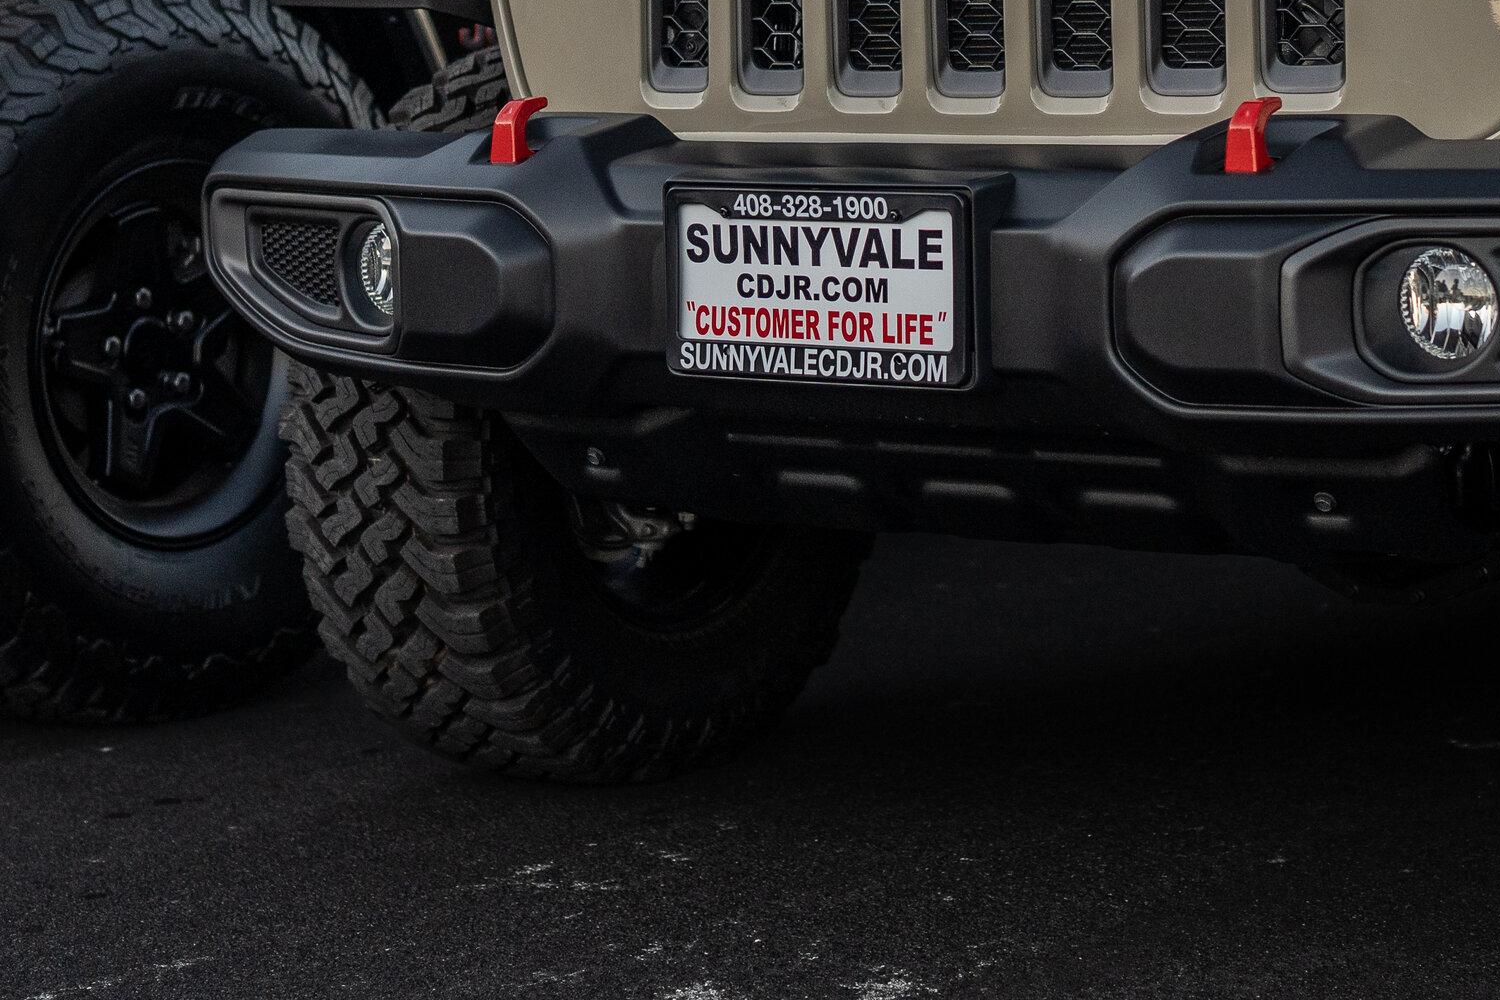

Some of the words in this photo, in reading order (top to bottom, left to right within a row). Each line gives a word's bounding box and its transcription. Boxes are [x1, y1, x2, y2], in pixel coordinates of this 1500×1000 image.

[733, 193, 888, 220] 408-328-1900
[686, 222, 944, 270] SUNNYVALE
[736, 273, 889, 304] CDJR.COM
[686, 301, 820, 340] "CUSTOMER
[827, 310, 874, 343] FOR
[679, 342, 947, 382] SUNNYVALECDJR.COM
